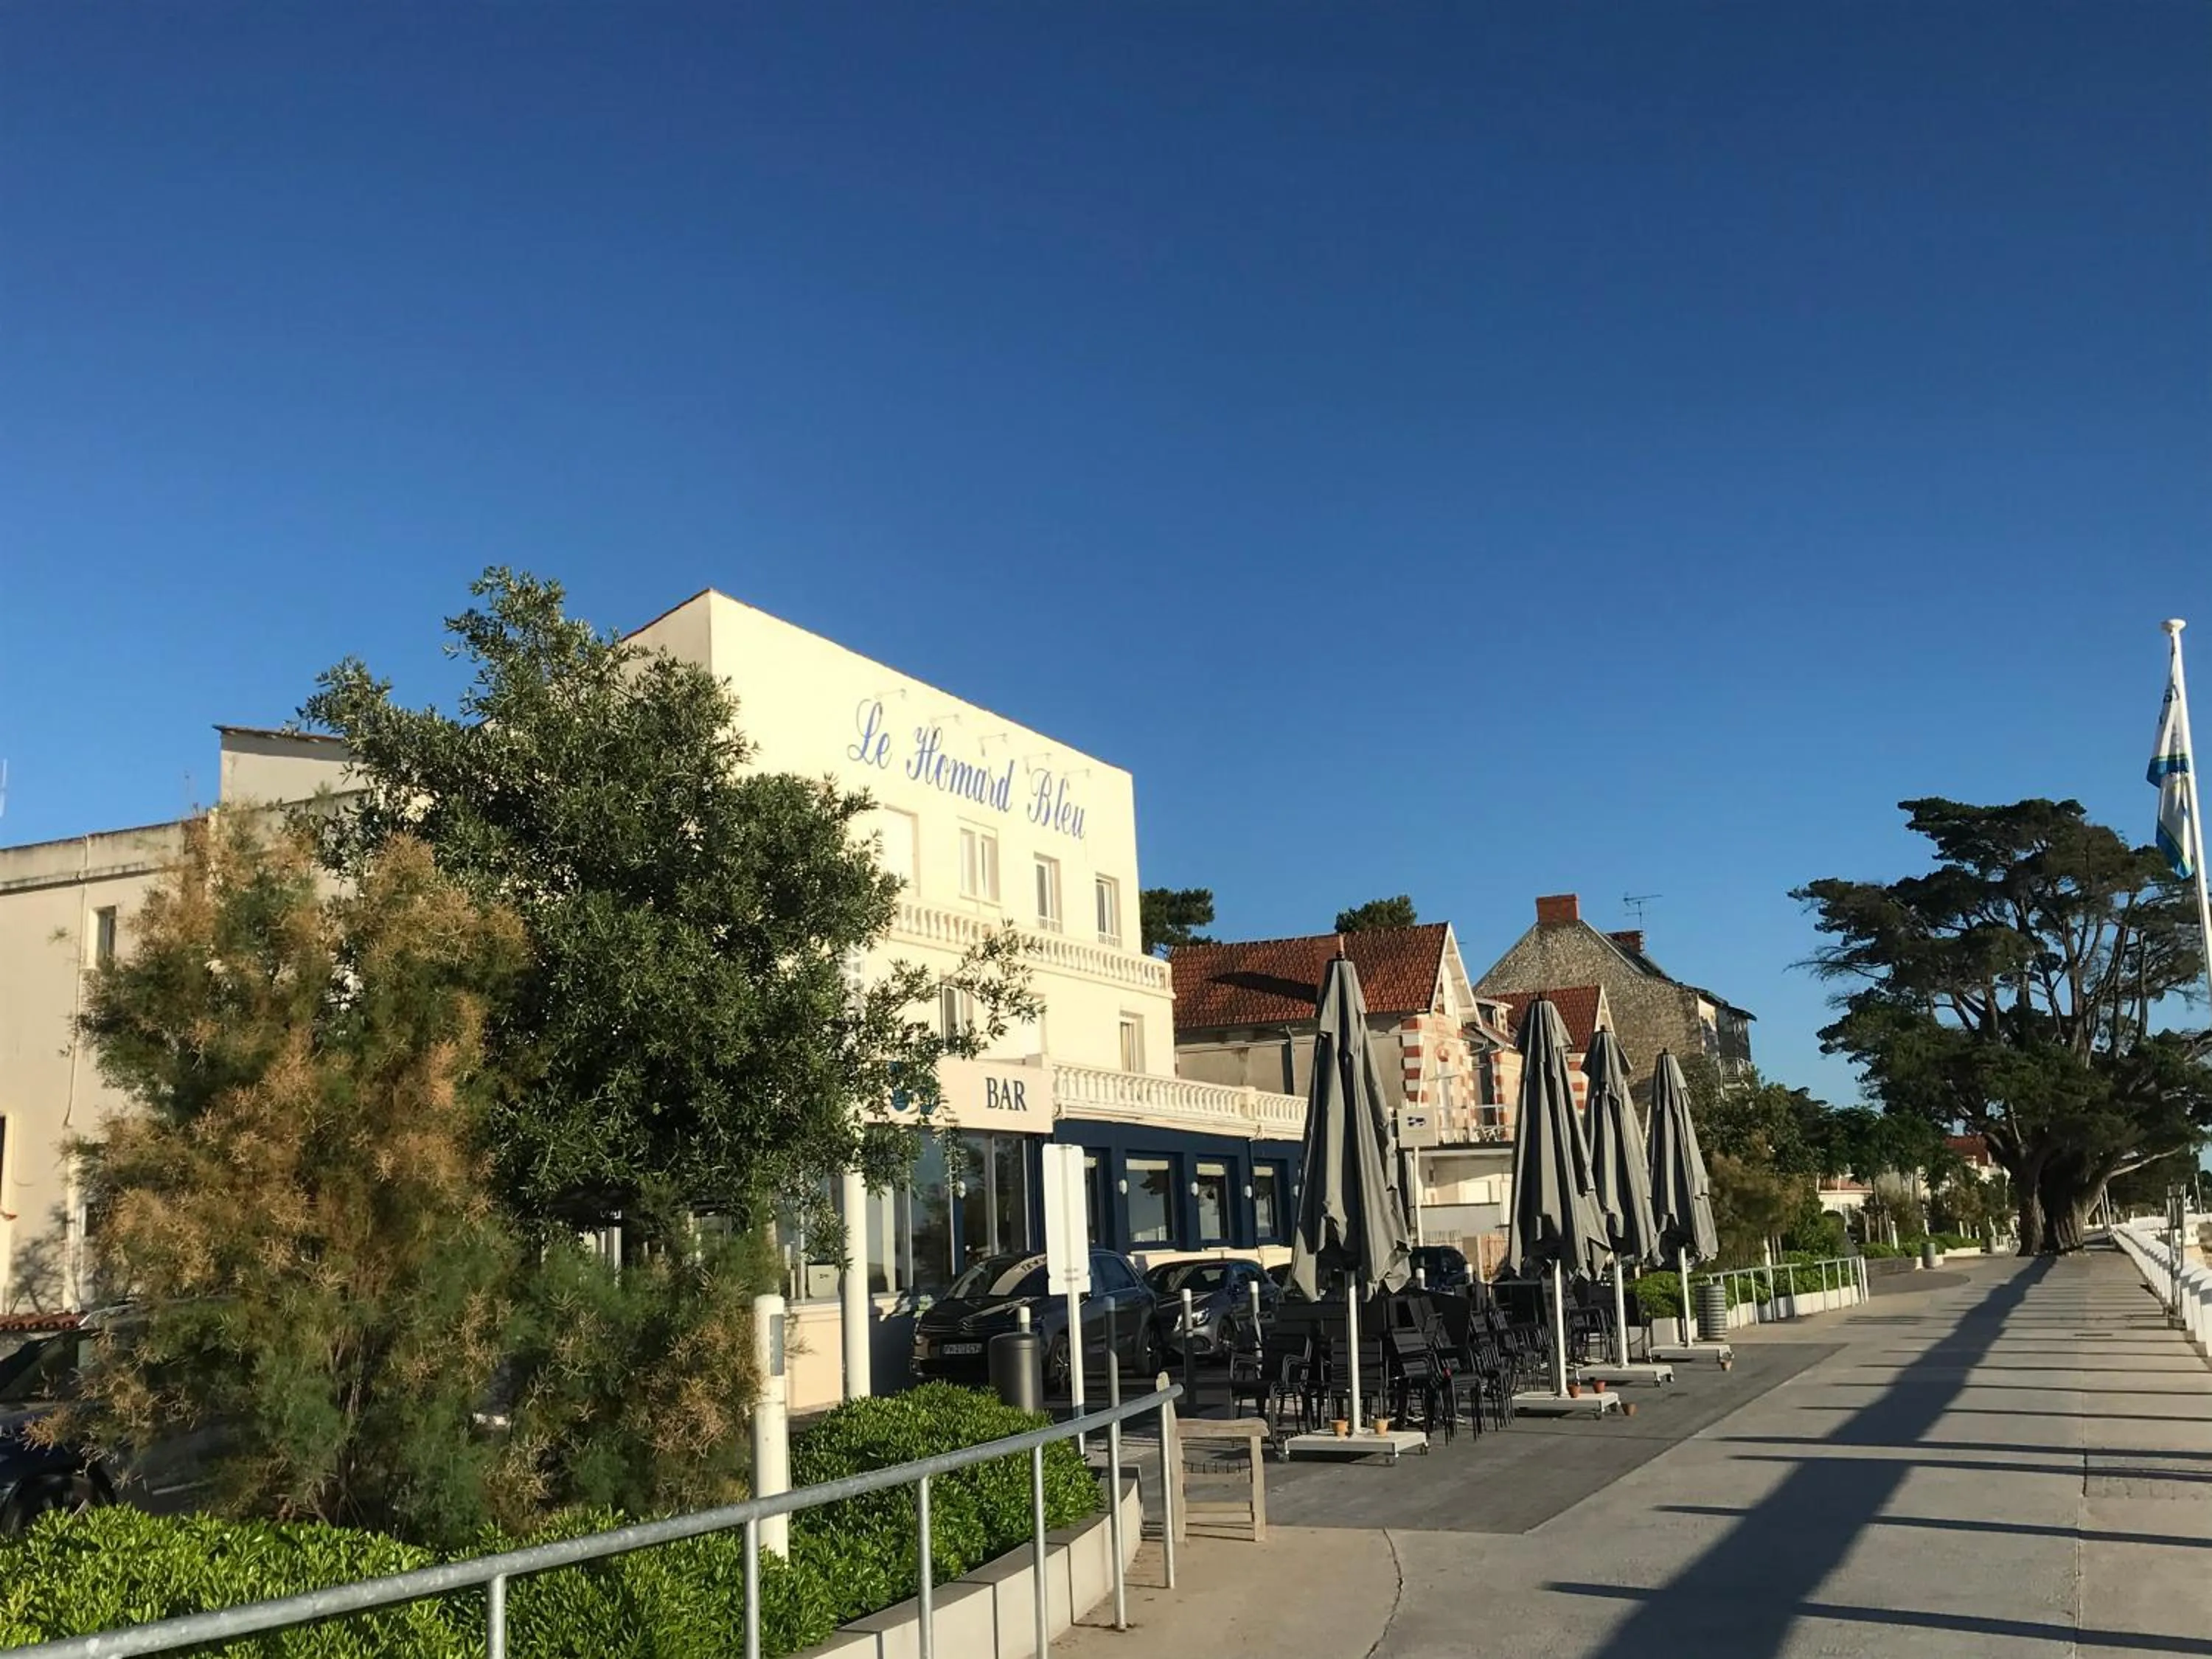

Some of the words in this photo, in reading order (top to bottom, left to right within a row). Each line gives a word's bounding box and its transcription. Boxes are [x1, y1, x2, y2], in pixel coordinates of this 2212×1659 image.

[846, 699, 892, 770] Le
[906, 726, 1015, 813] Homard
[1027, 768, 1085, 840] Bleu
[986, 1077, 1027, 1112] BAR
